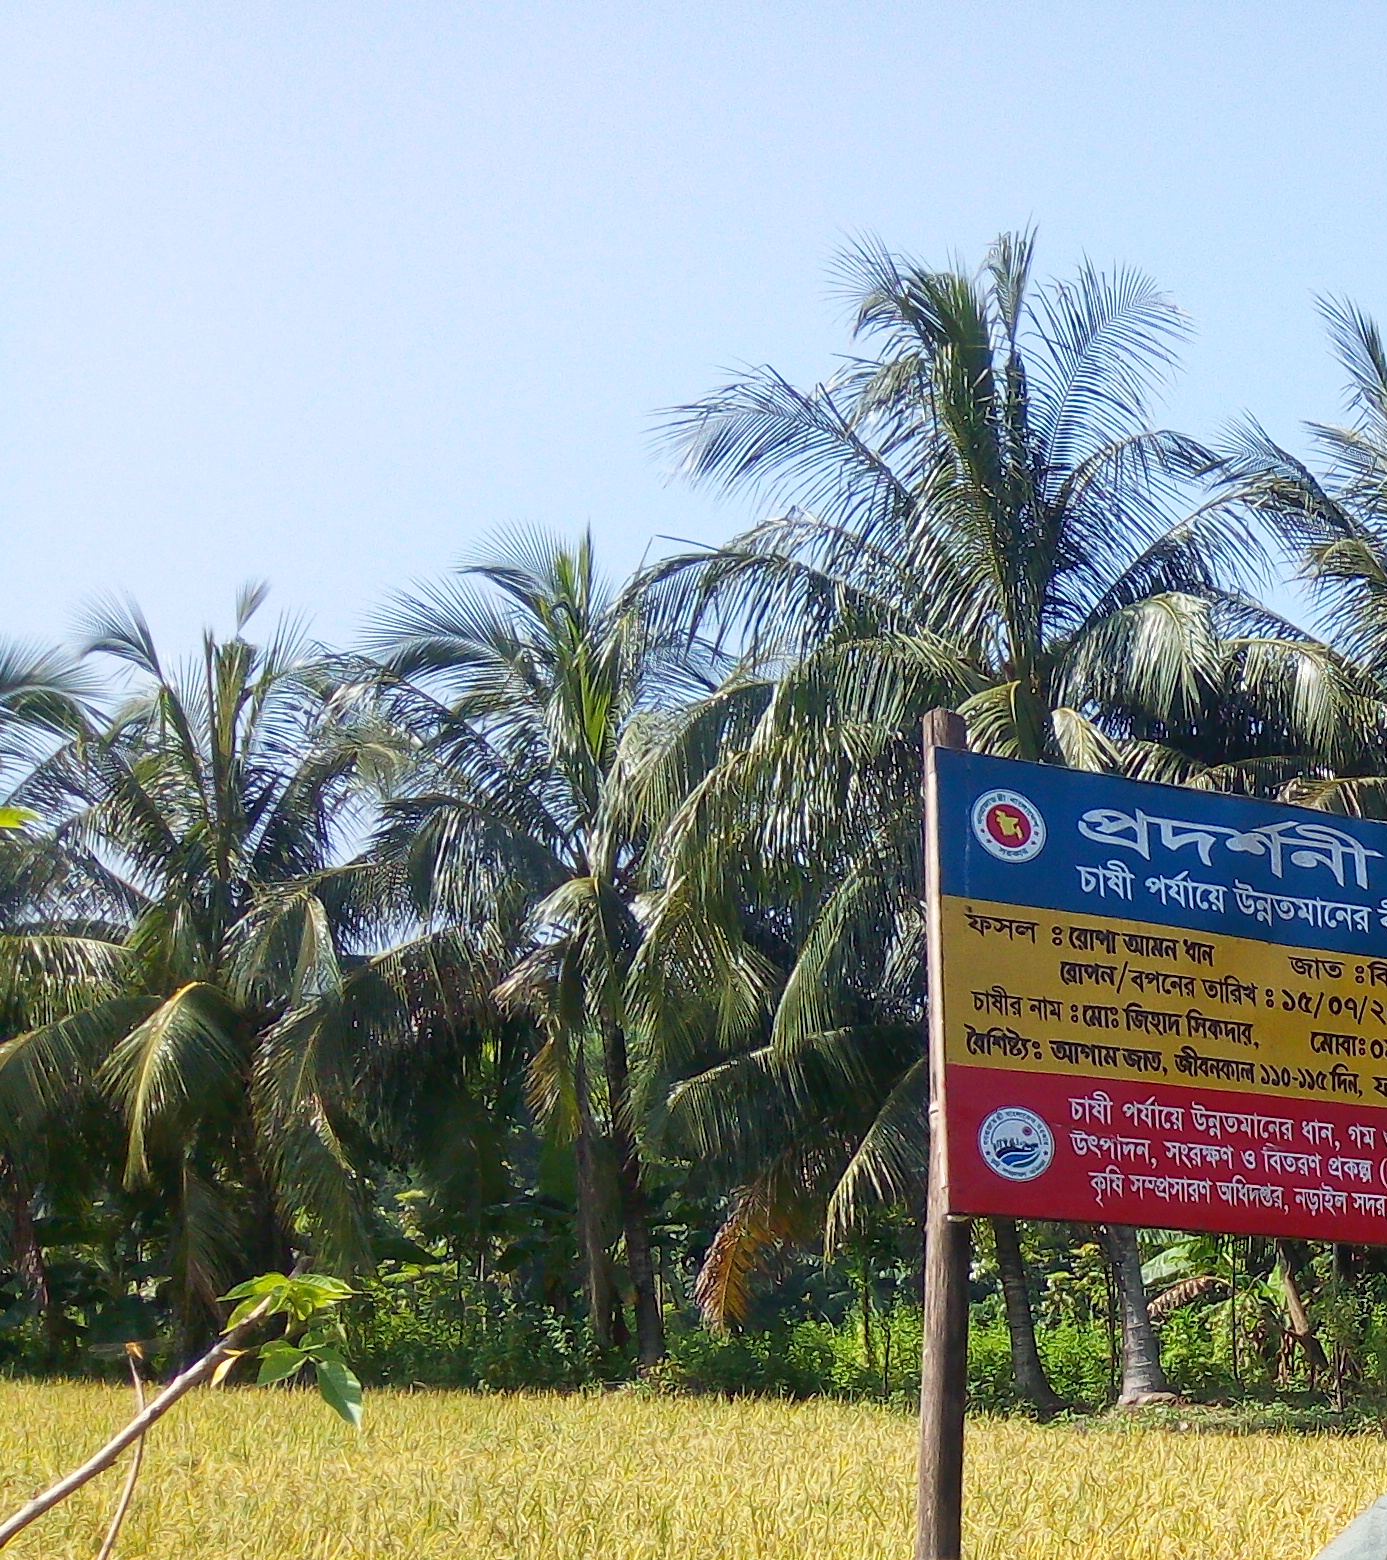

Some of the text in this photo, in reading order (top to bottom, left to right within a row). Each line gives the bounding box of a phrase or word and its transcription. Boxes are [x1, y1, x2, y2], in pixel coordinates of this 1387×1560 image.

[1077, 808, 1384, 890] প্রদর্শনী
[1075, 860, 1135, 901] চাষী
[1145, 871, 1228, 913] পর্যায়ে
[1232, 879, 1373, 933] উন্নতমানের
[965, 913, 1039, 943] ফসল
[1123, 935, 1179, 961] আমন
[1183, 938, 1215, 967] ধান
[1200, 975, 1258, 1006] তারিখ
[1288, 956, 1345, 979] জাত
[971, 985, 1023, 1018] চাষীর
[1027, 996, 1063, 1021] নাম
[1123, 1002, 1182, 1036] জিহাদ
[1049, 1039, 1121, 1067] আগাম
[1174, 1046, 1256, 1084] জীবনকাল
[1068, 1090, 1114, 1126] চাষী
[1122, 1096, 1186, 1132] পর্যায়ে
[1189, 1101, 1295, 1142] উন্নতমানের
[1348, 1123, 1377, 1150] গম
[1069, 1130, 1158, 1170] উৎপাদন,
[1163, 1139, 1235, 1170] সংরক্ষণ
[1239, 1148, 1257, 1170] ও
[1261, 1142, 1322, 1177] বিতরণ
[1327, 1154, 1373, 1184] প্রকল্প
[1088, 1164, 1125, 1207] কৃষি
[1128, 1174, 1213, 1204] সম্প্রসারণ
[1295, 1181, 1348, 1216] নড়াইল
